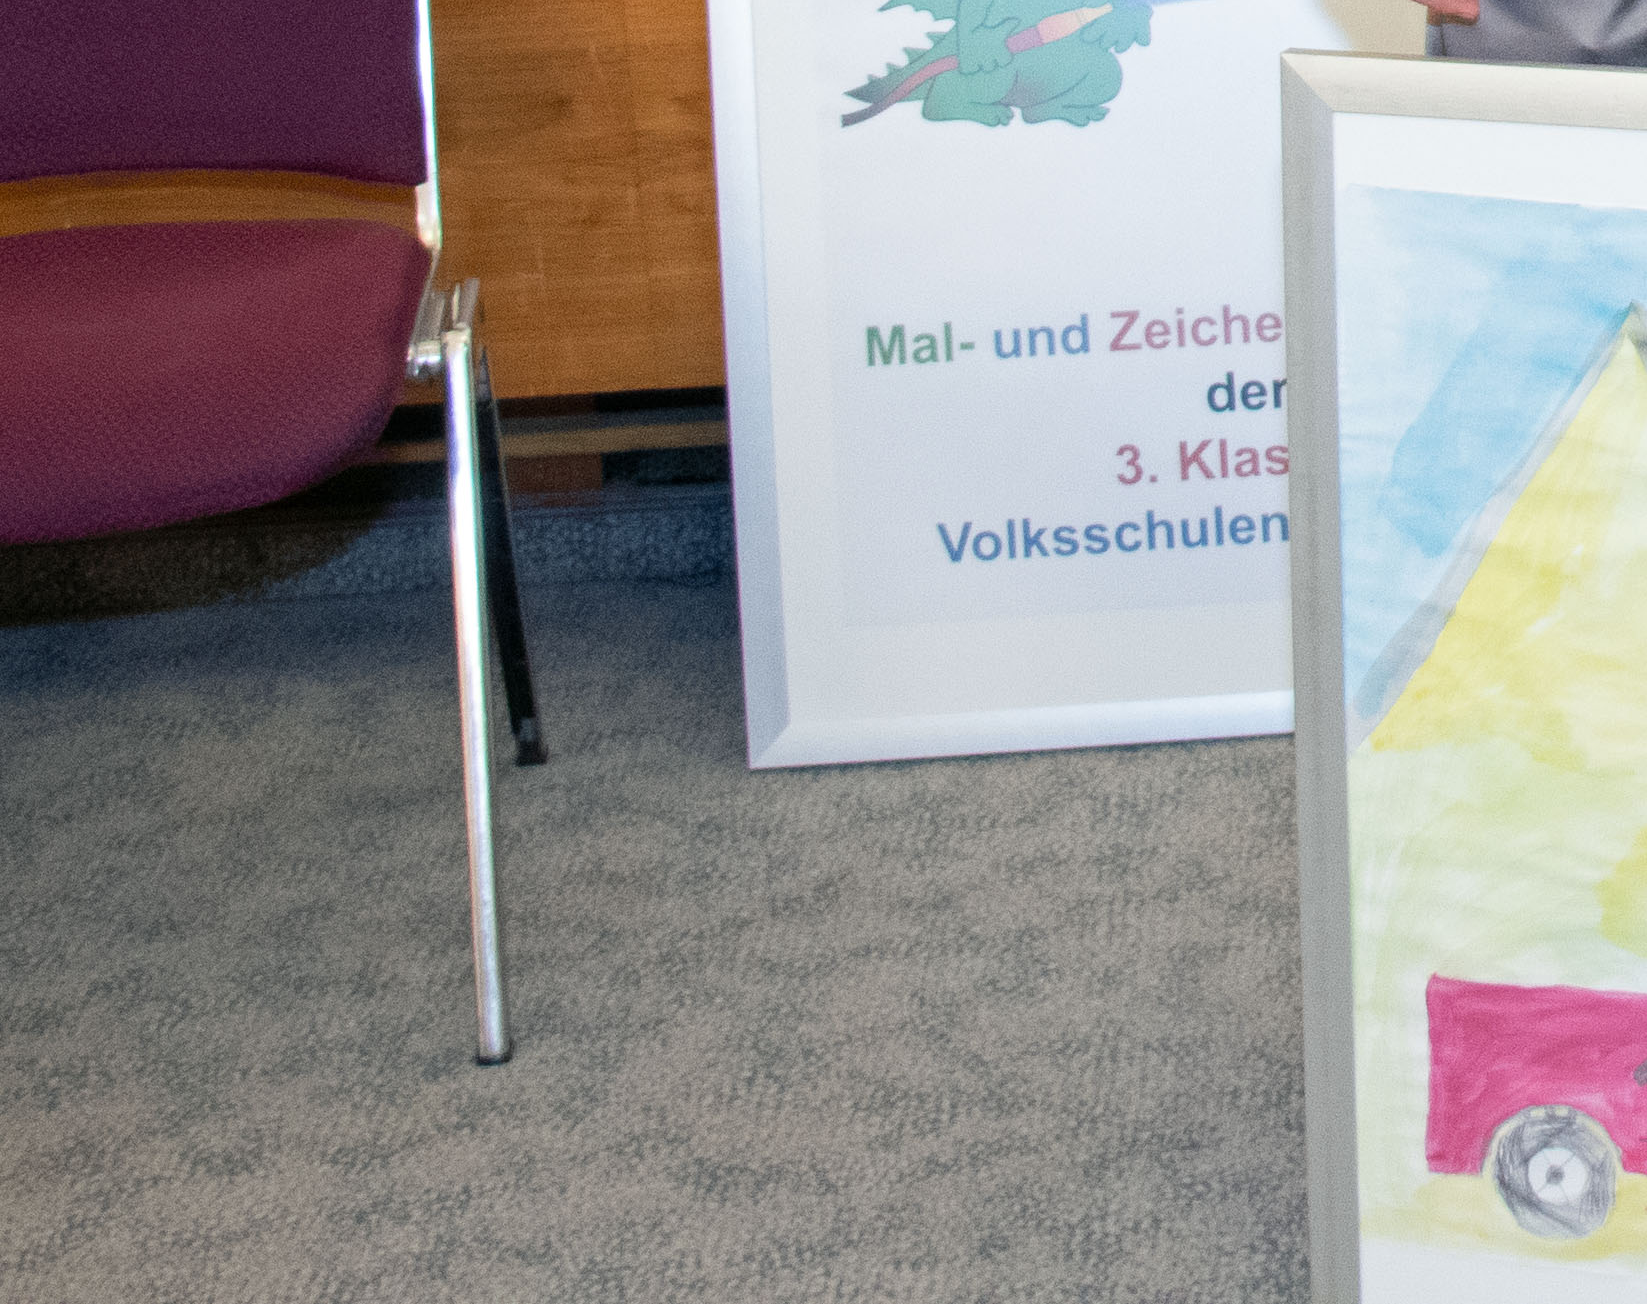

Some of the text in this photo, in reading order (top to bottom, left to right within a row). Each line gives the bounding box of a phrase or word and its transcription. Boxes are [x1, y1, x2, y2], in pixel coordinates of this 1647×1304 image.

[866, 303, 1283, 367] Mal- und Zeiche
[1206, 371, 1288, 413] der
[1115, 438, 1290, 486] 3. Klas
[937, 504, 1290, 564] Volksschulen
